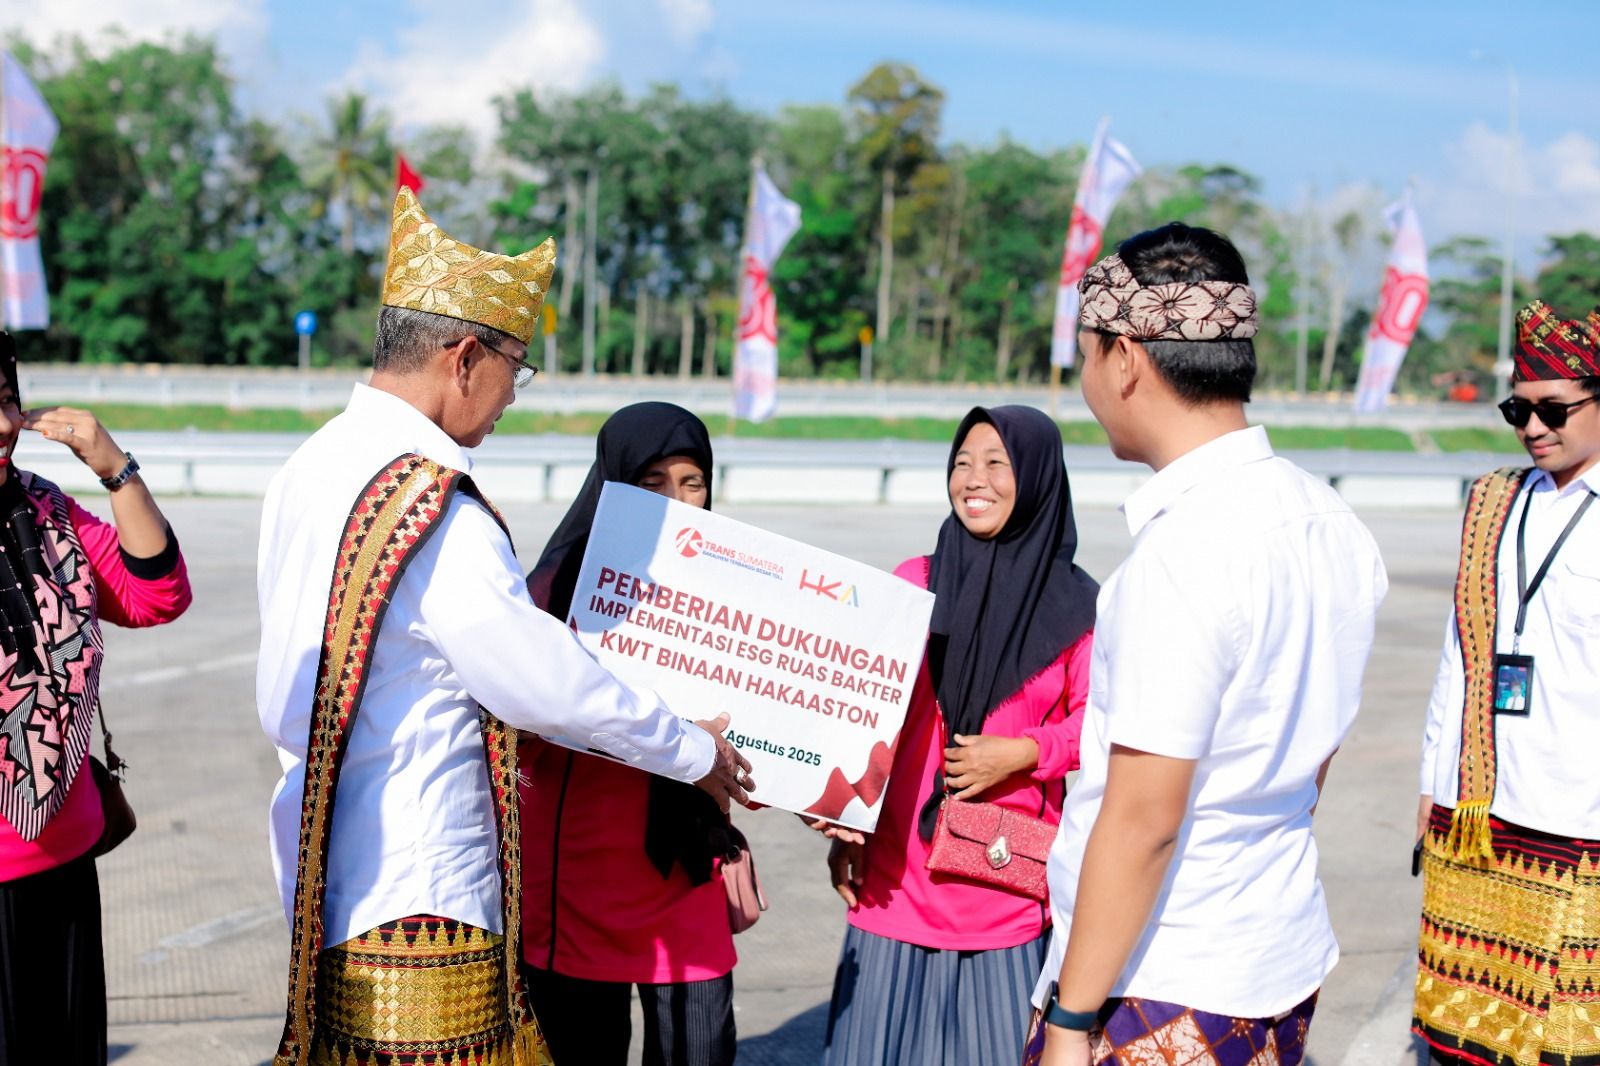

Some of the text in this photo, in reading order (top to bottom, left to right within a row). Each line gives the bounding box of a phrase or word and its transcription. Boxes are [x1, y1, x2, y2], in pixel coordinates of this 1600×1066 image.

[705, 541, 784, 574] TRANS SUMATERA
[799, 568, 859, 608] HKA
[589, 595, 902, 705] IMPLEMENTASI ESG RUAS BAKTER
[597, 566, 907, 684] PEMBERIAN DUKUNGAN
[600, 630, 879, 729] KWT BINAAN HAKAASTON
[725, 730, 822, 766] Agustus 2025
